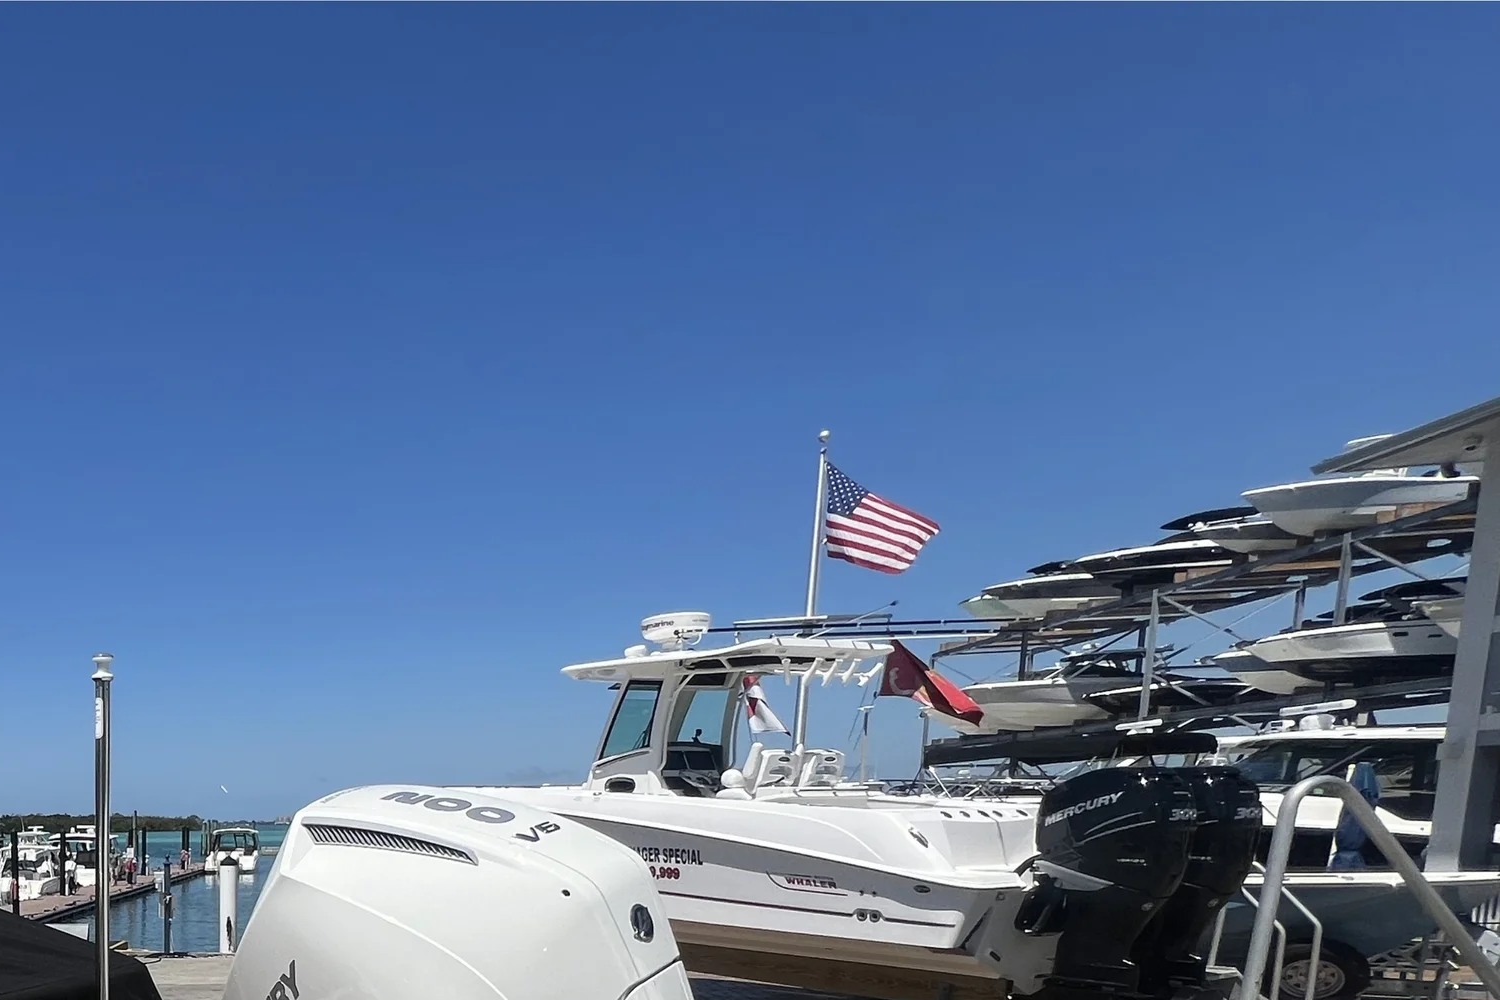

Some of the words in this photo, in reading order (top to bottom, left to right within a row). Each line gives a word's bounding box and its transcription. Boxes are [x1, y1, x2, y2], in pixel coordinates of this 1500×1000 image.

[1044, 791, 1125, 827] MERCURY
[513, 821, 561, 842] V6
[629, 846, 660, 862] AGER
[663, 848, 703, 865] SPECIAL
[785, 876, 837, 889] WHALER
